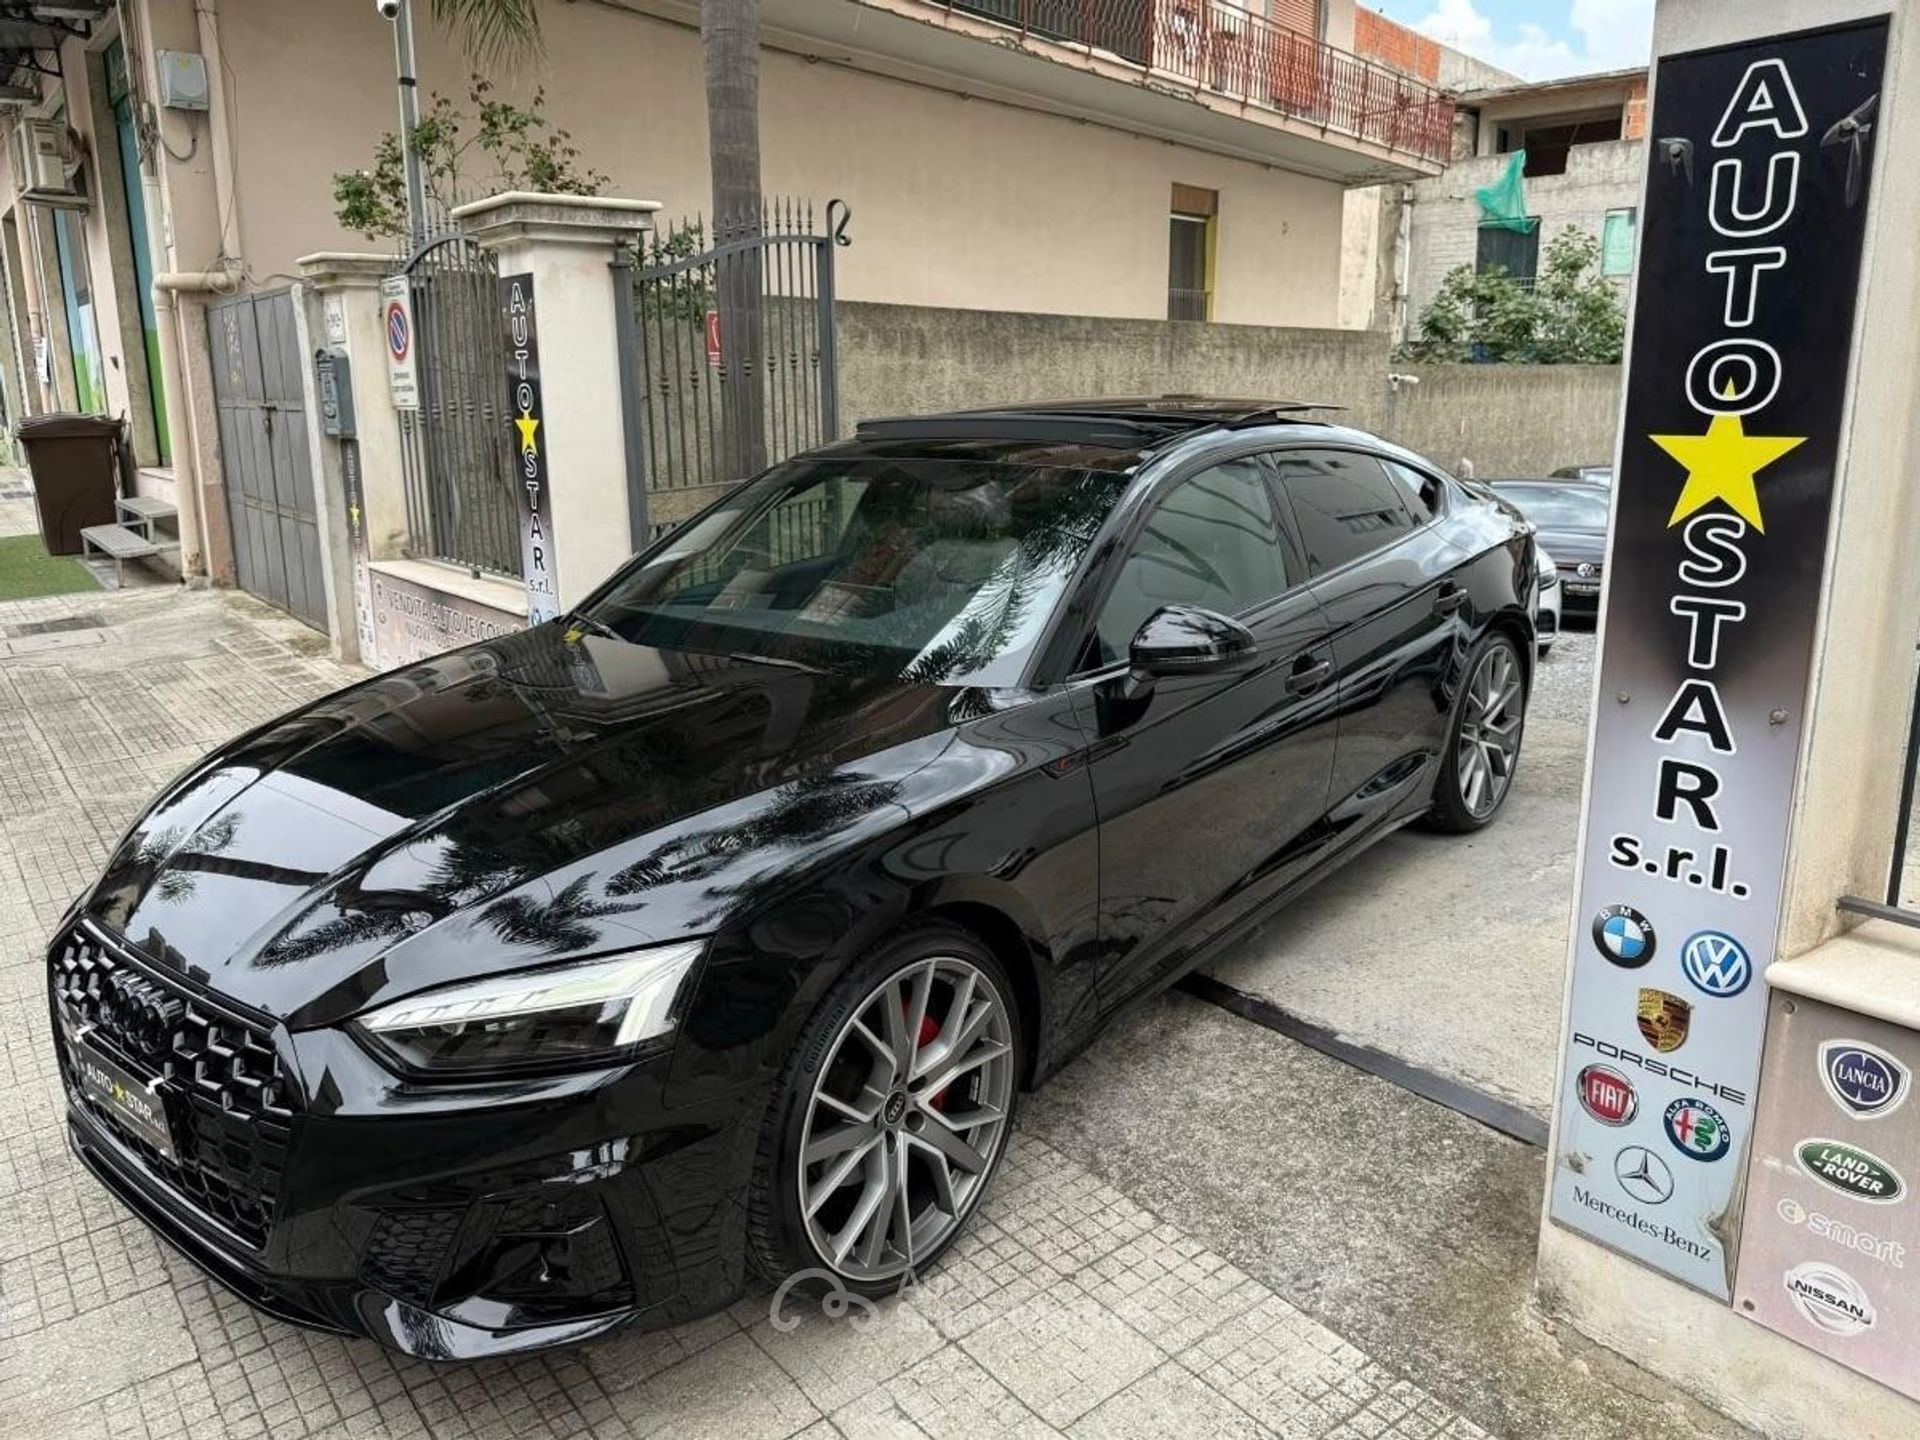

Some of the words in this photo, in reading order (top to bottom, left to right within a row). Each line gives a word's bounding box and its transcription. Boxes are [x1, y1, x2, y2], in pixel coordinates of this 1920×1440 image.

[1686, 58, 1808, 416] AUTO
[511, 283, 534, 413] AUTO
[525, 449, 546, 572] STAR
[530, 578, 553, 595] s.r.l.
[1651, 513, 1747, 832] STAR
[1609, 834, 1751, 897] s.r.l.
[1600, 905, 1652, 933] BMW
[1573, 1032, 1746, 1106] PORSCHE
[1837, 1062, 1887, 1095] LANCIA
[1591, 1080, 1627, 1113] FIAT
[1666, 1101, 1690, 1120] ALFA
[1695, 1101, 1730, 1143] ROMEO
[1820, 1149, 1870, 1175] LAND
[1822, 1160, 1884, 1194] ROVER
[1572, 1185, 1712, 1263] Mercedes-Benz
[1807, 1211, 1905, 1269] smart
[1794, 1279, 1865, 1319] NISSAN
